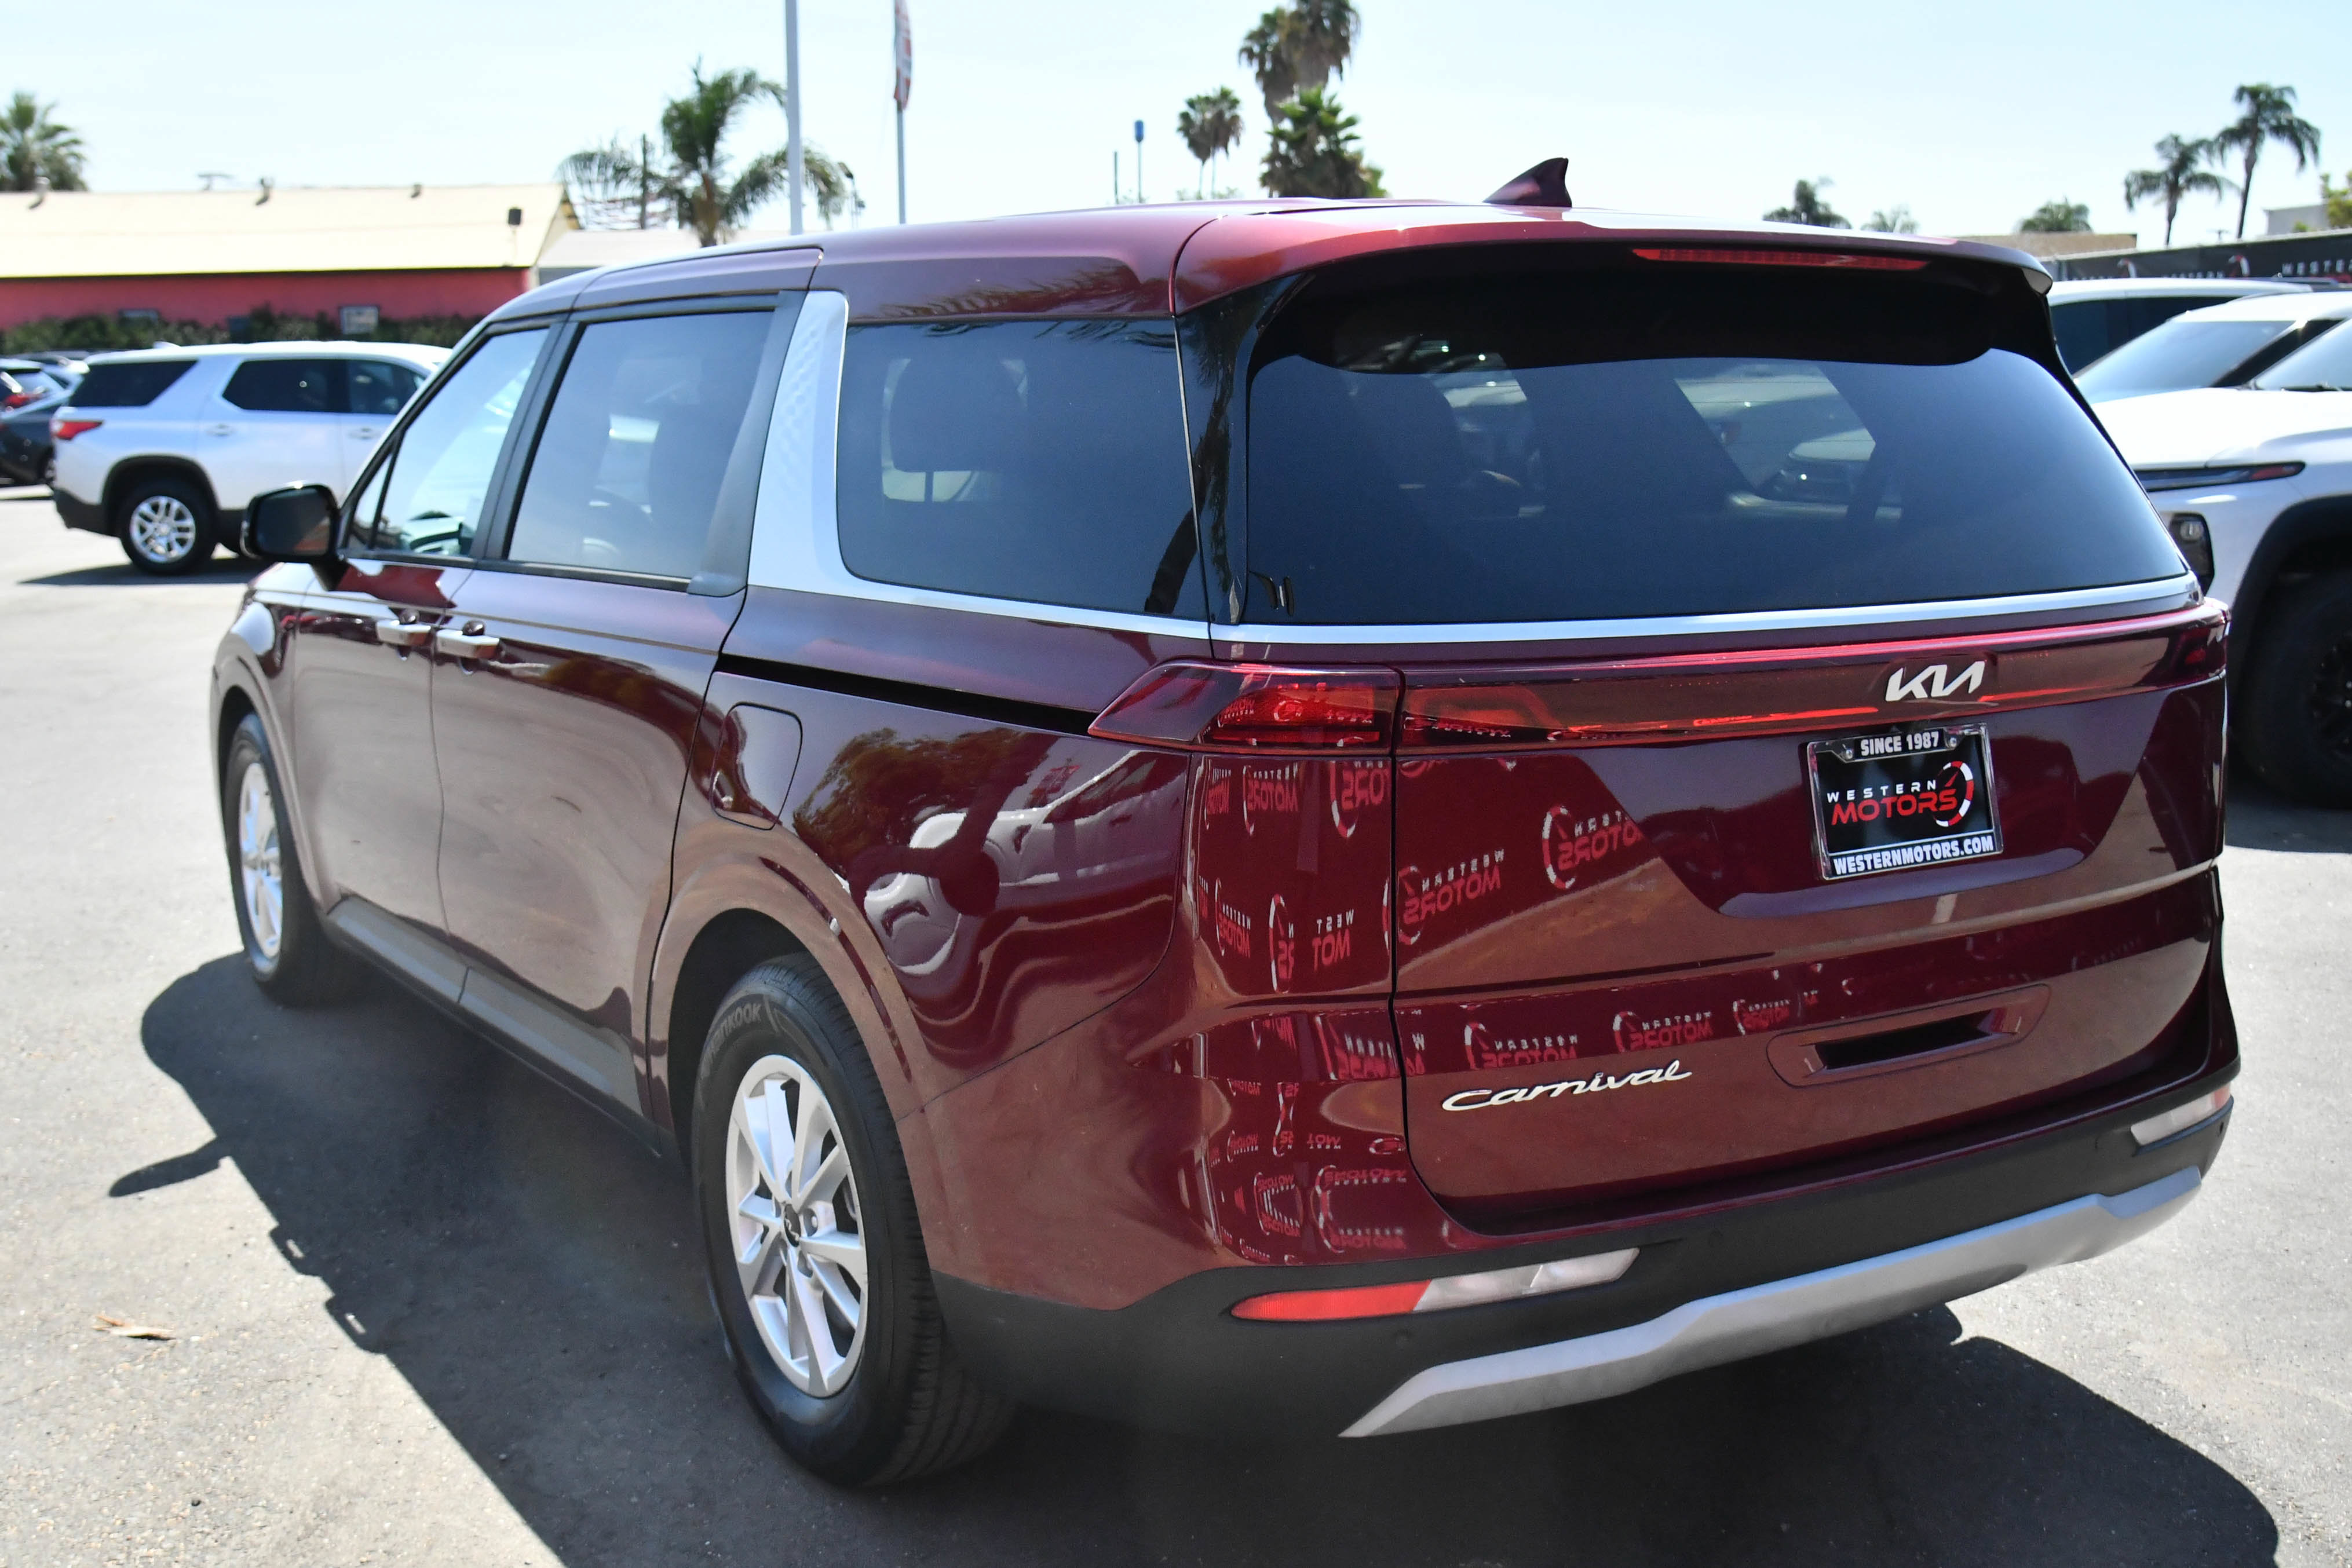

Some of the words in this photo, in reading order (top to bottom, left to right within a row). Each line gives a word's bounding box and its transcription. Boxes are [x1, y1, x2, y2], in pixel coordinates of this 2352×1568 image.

[1861, 736, 1901, 756] SINCE
[1907, 731, 1939, 750] 1987
[1827, 780, 1936, 803] WESTERN
[1831, 789, 1957, 825] MOTORS
[1834, 835, 1993, 875] WESTERNMOTORS.COM
[1442, 1059, 1693, 1112] Carnival
